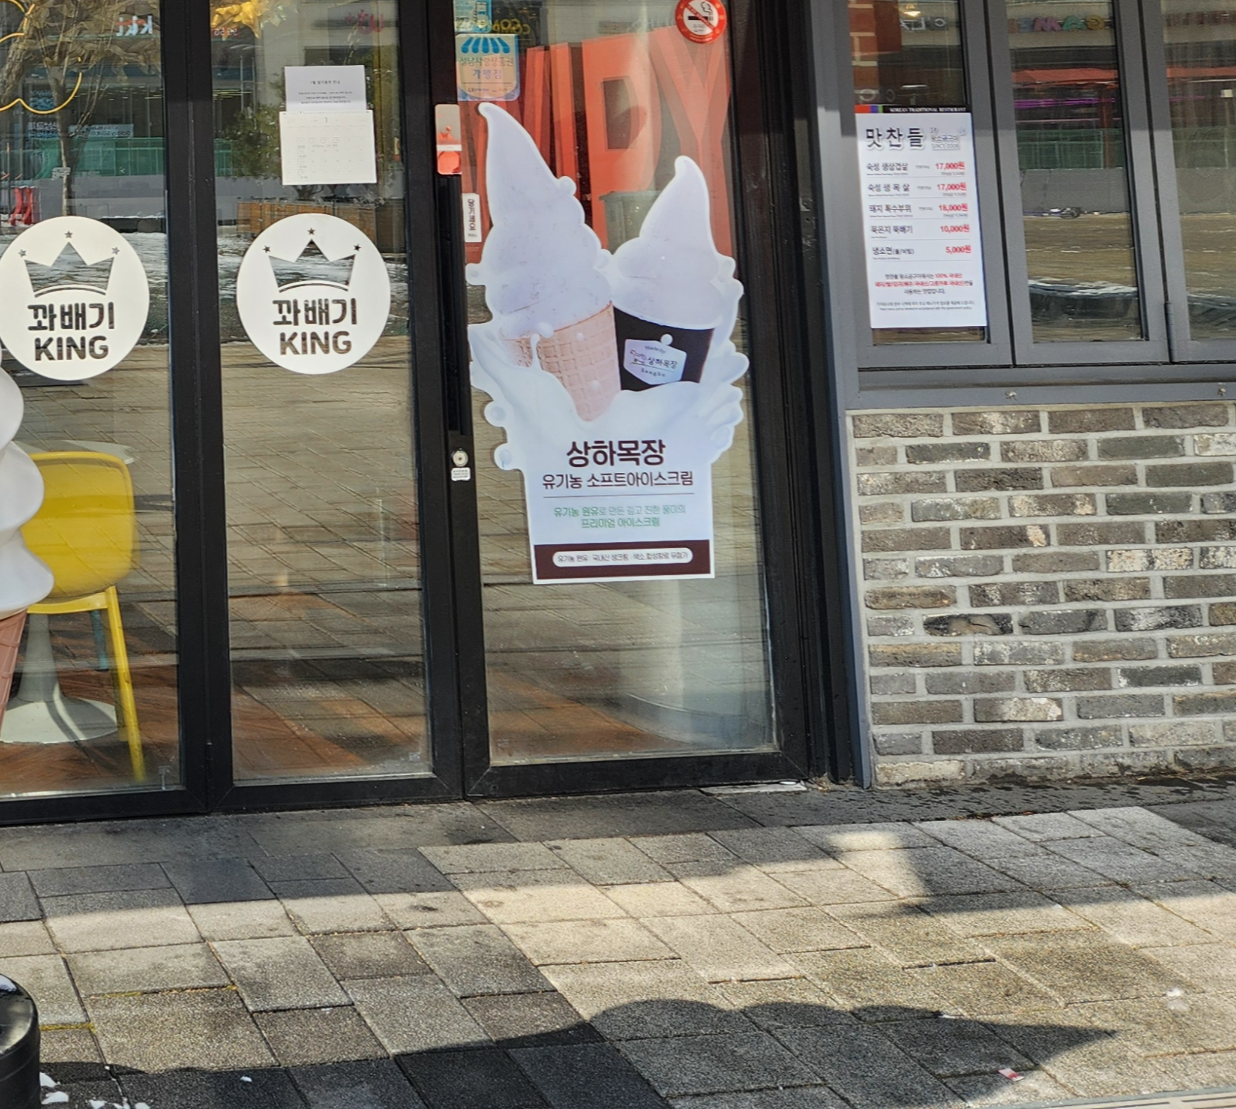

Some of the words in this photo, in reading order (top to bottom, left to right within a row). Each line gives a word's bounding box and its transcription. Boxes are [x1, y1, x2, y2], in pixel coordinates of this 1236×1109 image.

[472, 69, 502, 80] 가맹점
[866, 127, 924, 148] 맛찬들
[935, 162, 965, 171] 17,000원
[937, 182, 967, 191] 17,000원
[940, 224, 970, 233] 10,000원
[945, 245, 971, 254] 5,000원
[26, 301, 116, 332] 꽈배기
[271, 297, 358, 327] 꽈배기
[34, 335, 109, 362] KING
[279, 330, 353, 356] KING
[565, 439, 666, 468] 상하목장
[542, 474, 583, 490] 유기농
[586, 471, 694, 488] 소프트아이스크림
[553, 507, 580, 518] 유기농
[581, 518, 616, 529] 프리미엄
[617, 517, 661, 528] 아이스크림
